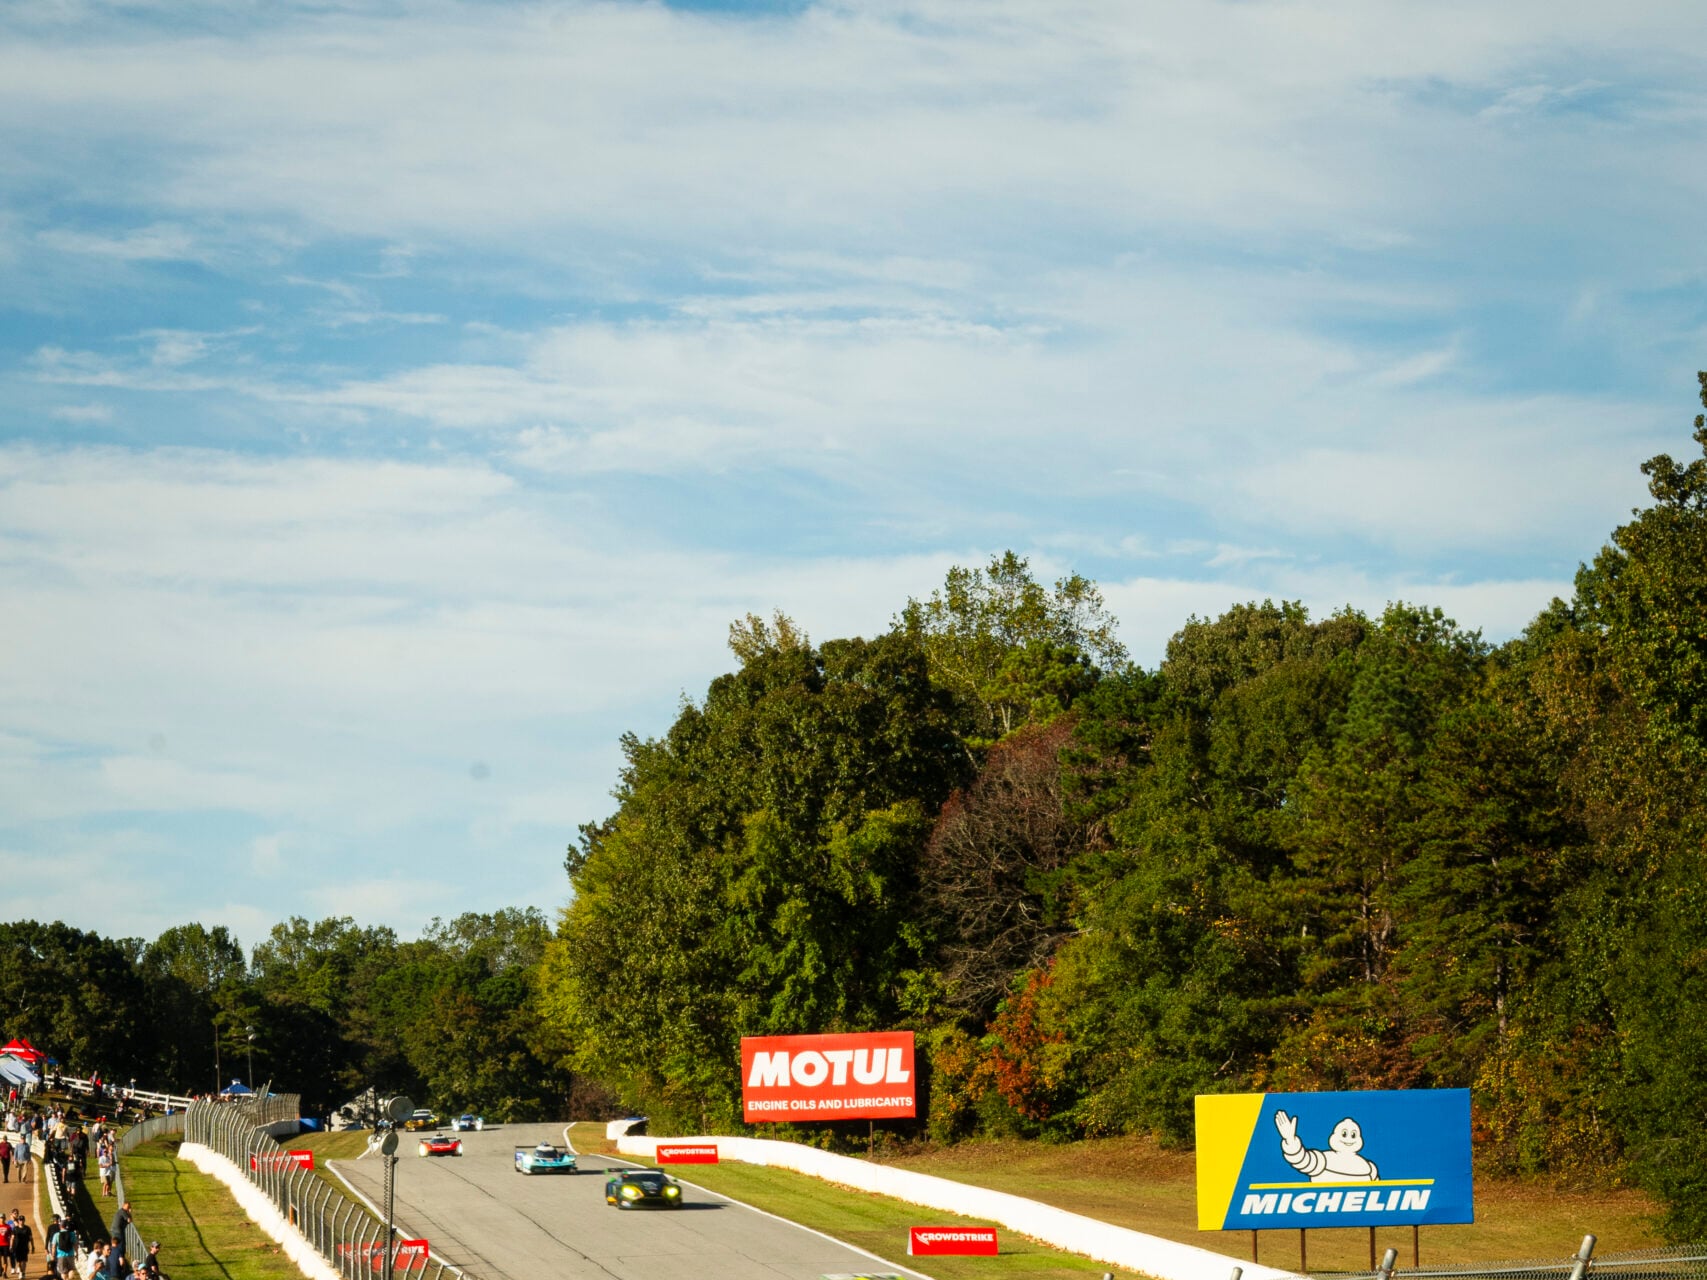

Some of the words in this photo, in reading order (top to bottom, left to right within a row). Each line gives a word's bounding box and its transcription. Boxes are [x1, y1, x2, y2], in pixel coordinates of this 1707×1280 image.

[747, 1048, 911, 1087] MOTUL
[748, 1100, 789, 1111] ENGINE
[790, 1099, 816, 1110] OILS
[818, 1098, 842, 1109] AND
[844, 1097, 912, 1108] LUBRICANTS
[1240, 1190, 1431, 1215] MICHELIN
[921, 1232, 994, 1242] CROWDSTRIKE
